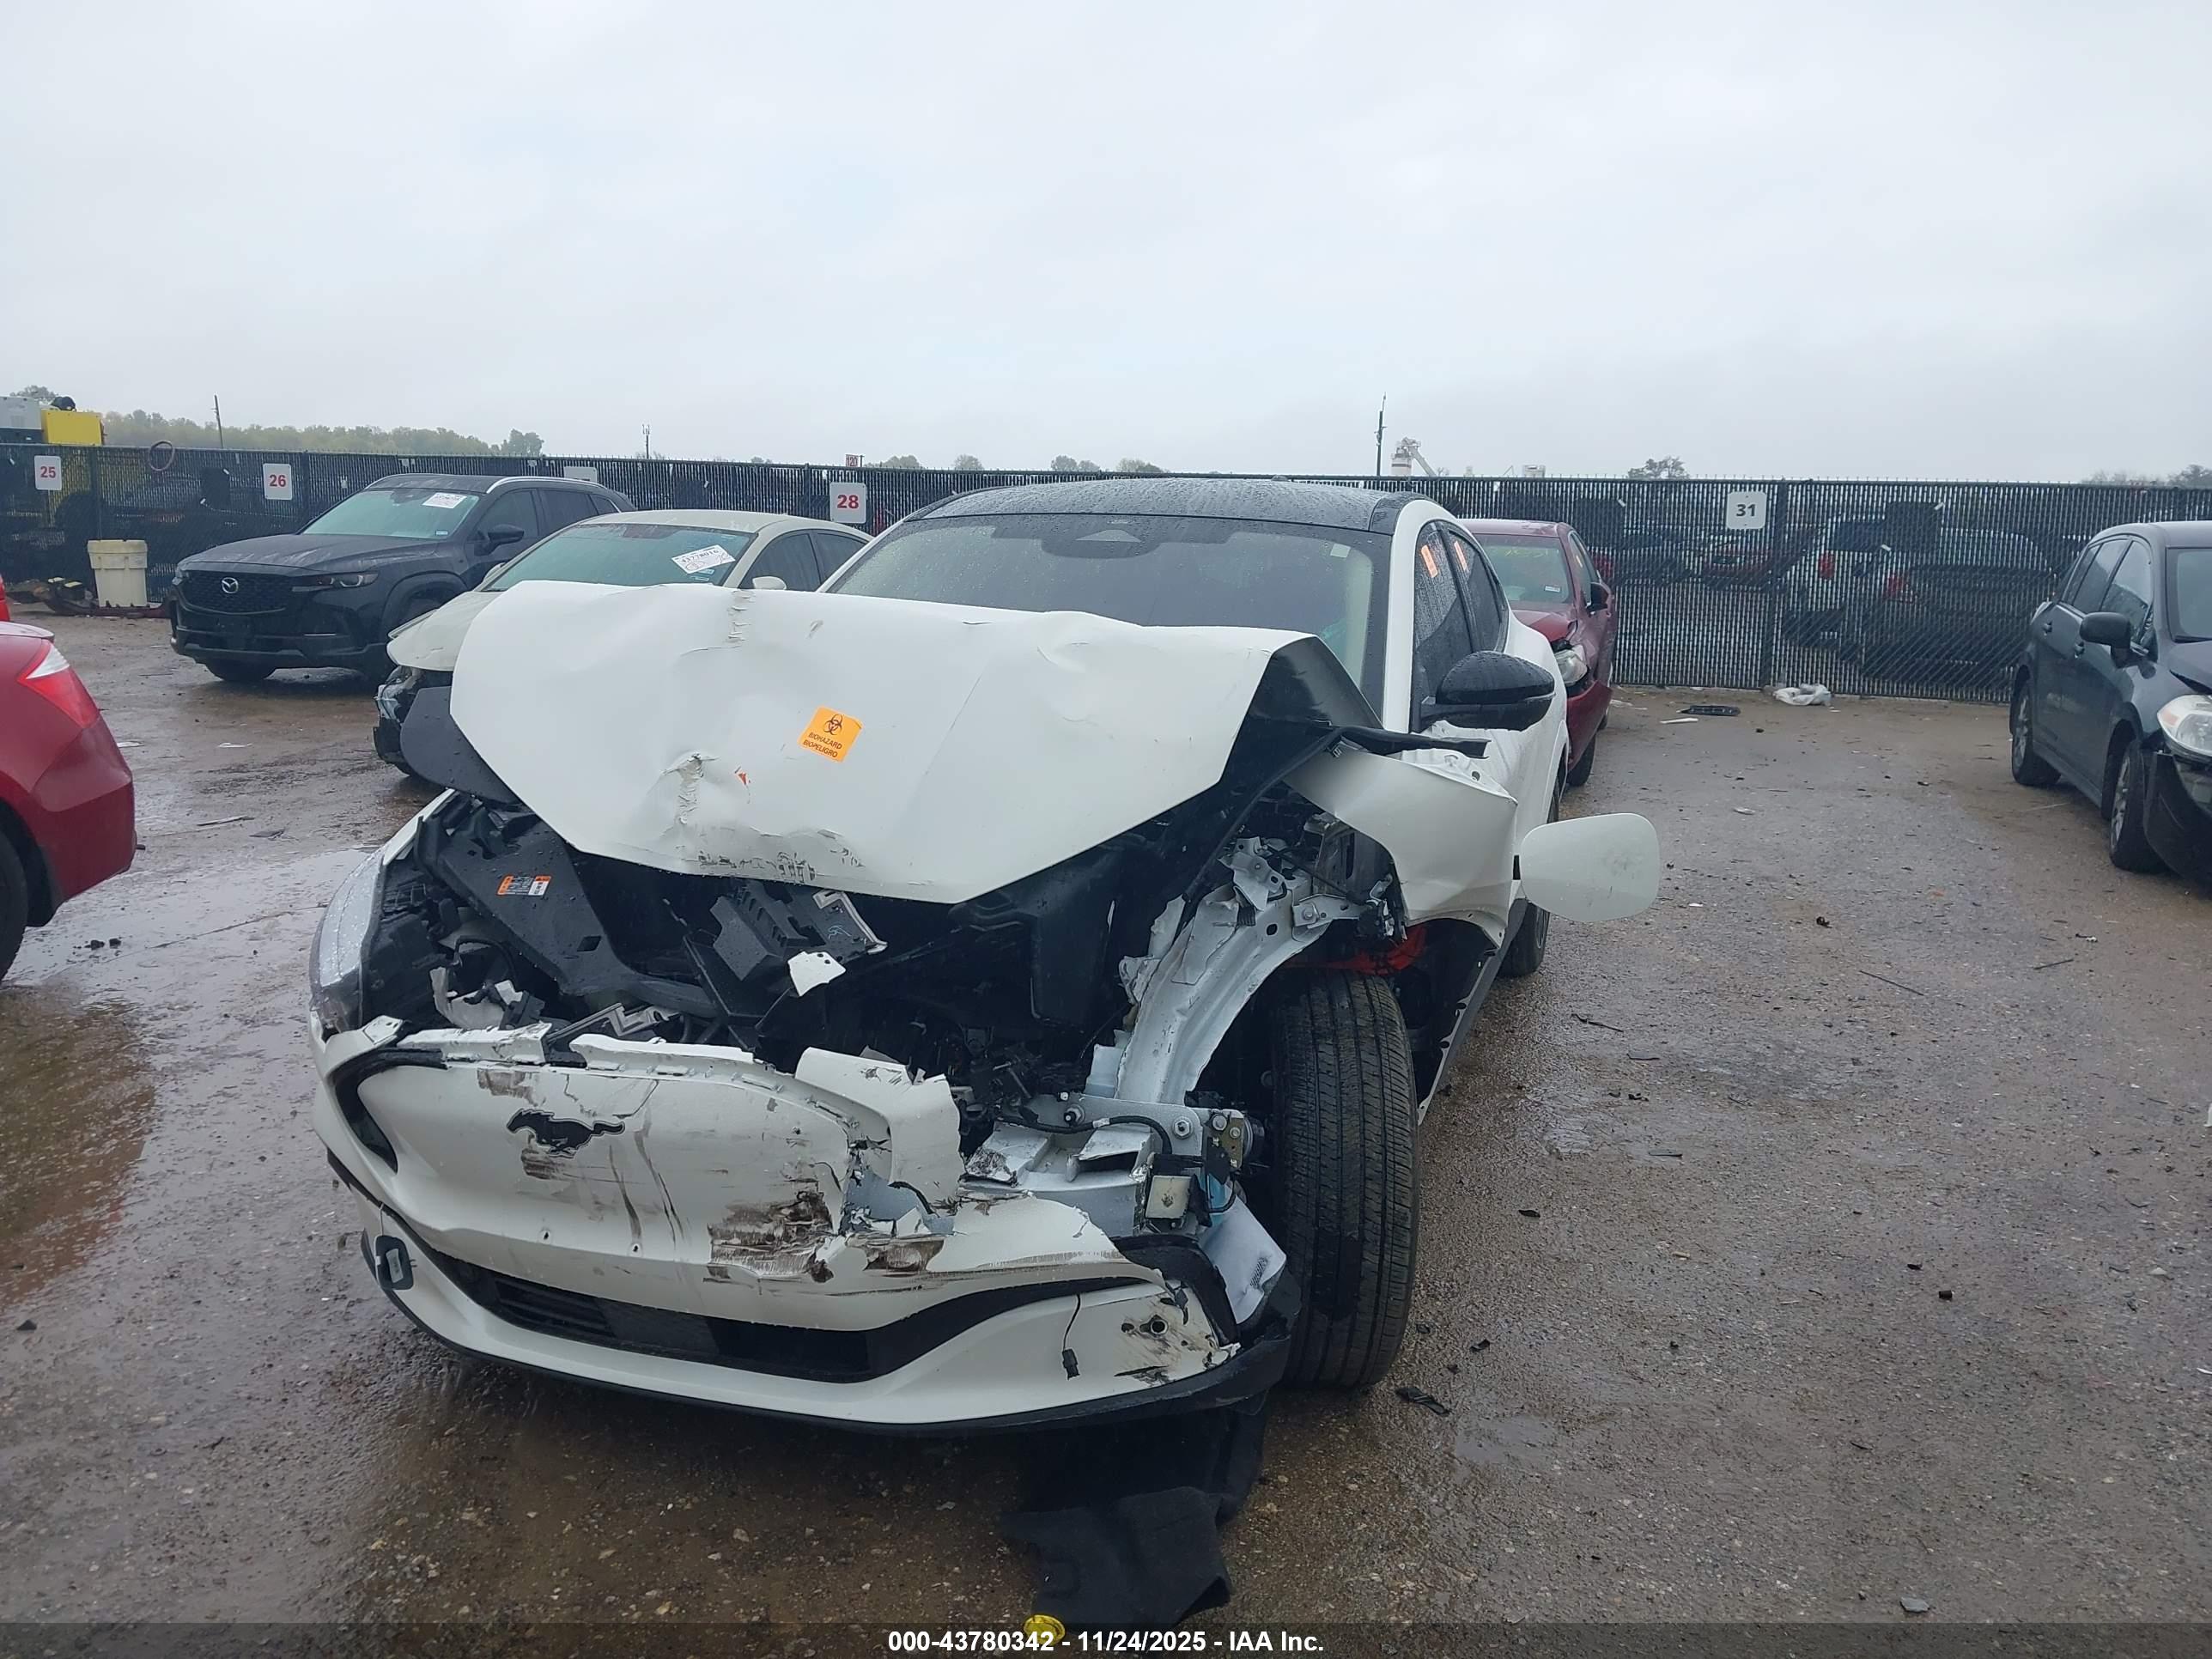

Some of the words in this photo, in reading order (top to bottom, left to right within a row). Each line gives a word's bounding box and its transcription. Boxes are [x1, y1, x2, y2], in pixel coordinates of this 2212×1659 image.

[40, 466, 56, 478] 25
[270, 475, 286, 487] 26
[837, 495, 859, 508] 28
[1735, 504, 1756, 517] 31
[808, 732, 842, 750] BIOHAZARD
[803, 739, 838, 757] BIOPELIGRO
